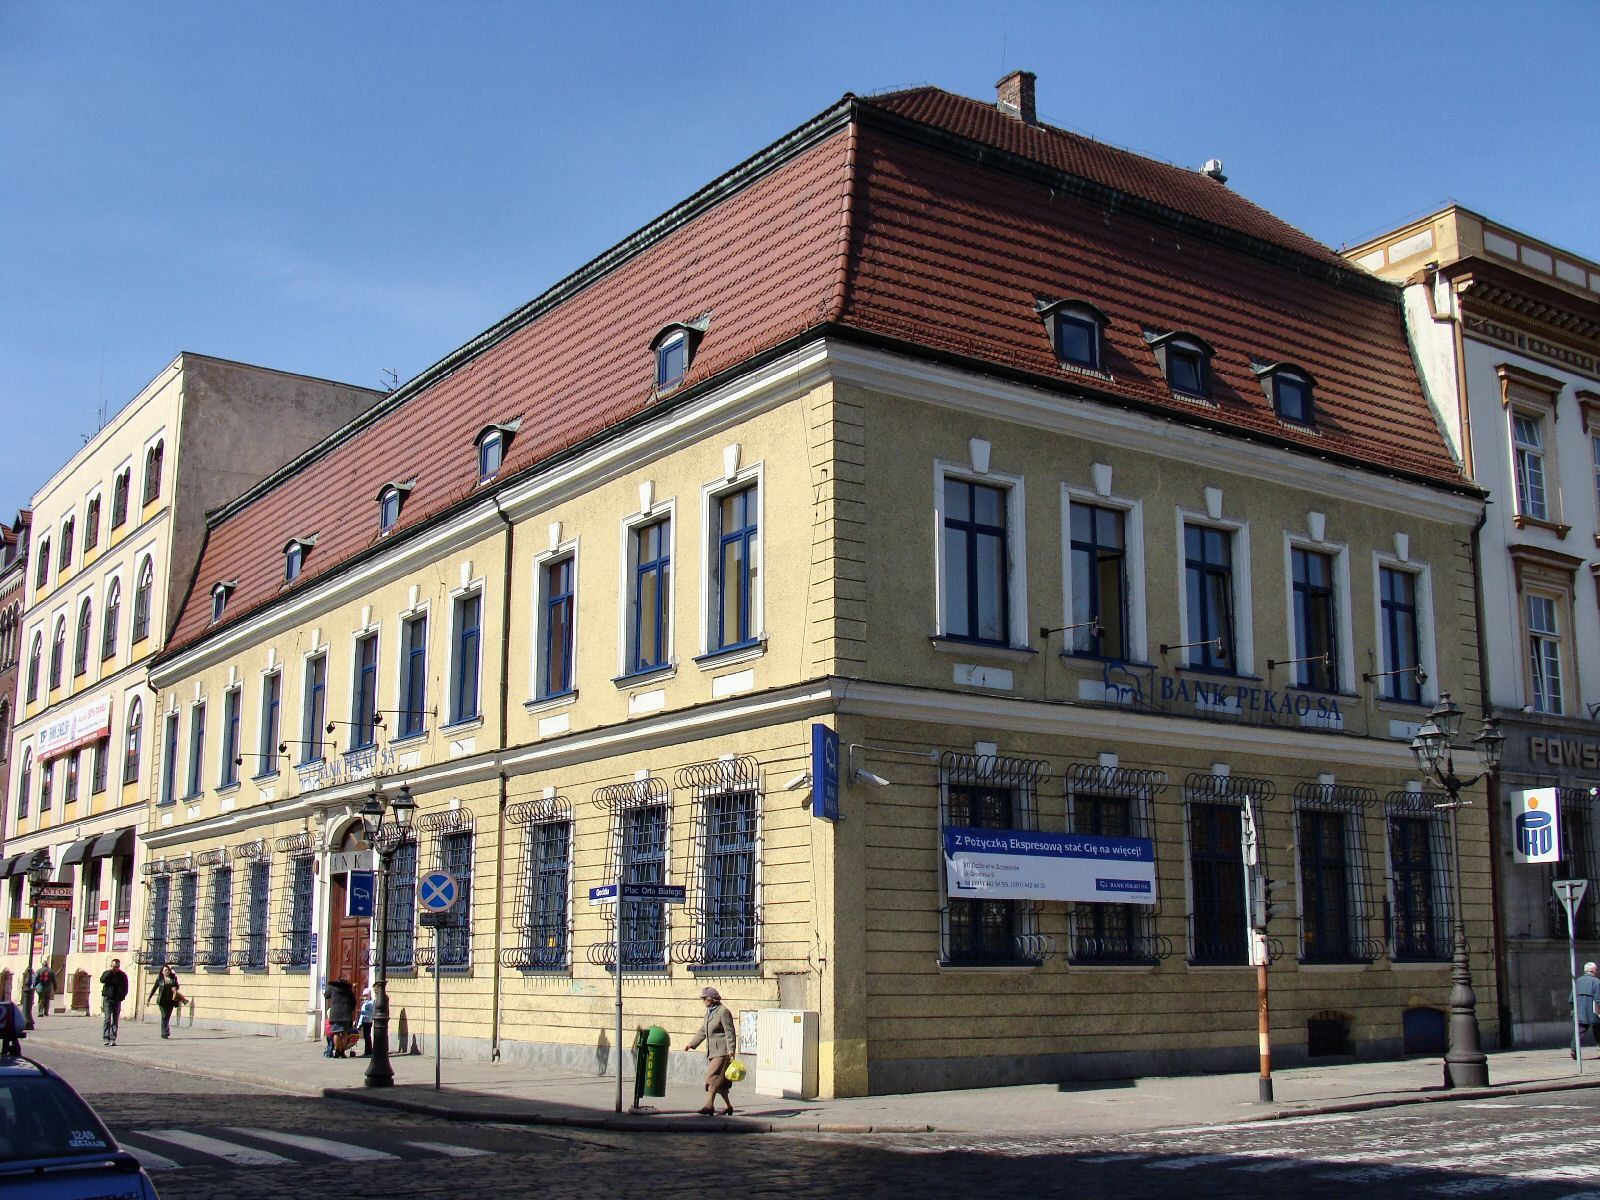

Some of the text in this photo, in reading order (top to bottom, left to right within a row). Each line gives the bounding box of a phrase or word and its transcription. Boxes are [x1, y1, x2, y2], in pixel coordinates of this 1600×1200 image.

[1161, 676, 1342, 721] BANK PEKAO SA
[320, 747, 395, 779] BANK PEKAO SA
[1529, 736, 1600, 770] POWS
[955, 835, 1142, 858] Z Pożyczką Ekspresową stać Cię na więcej!
[1516, 810, 1553, 857] PKO
[333, 853, 363, 871] ANK
